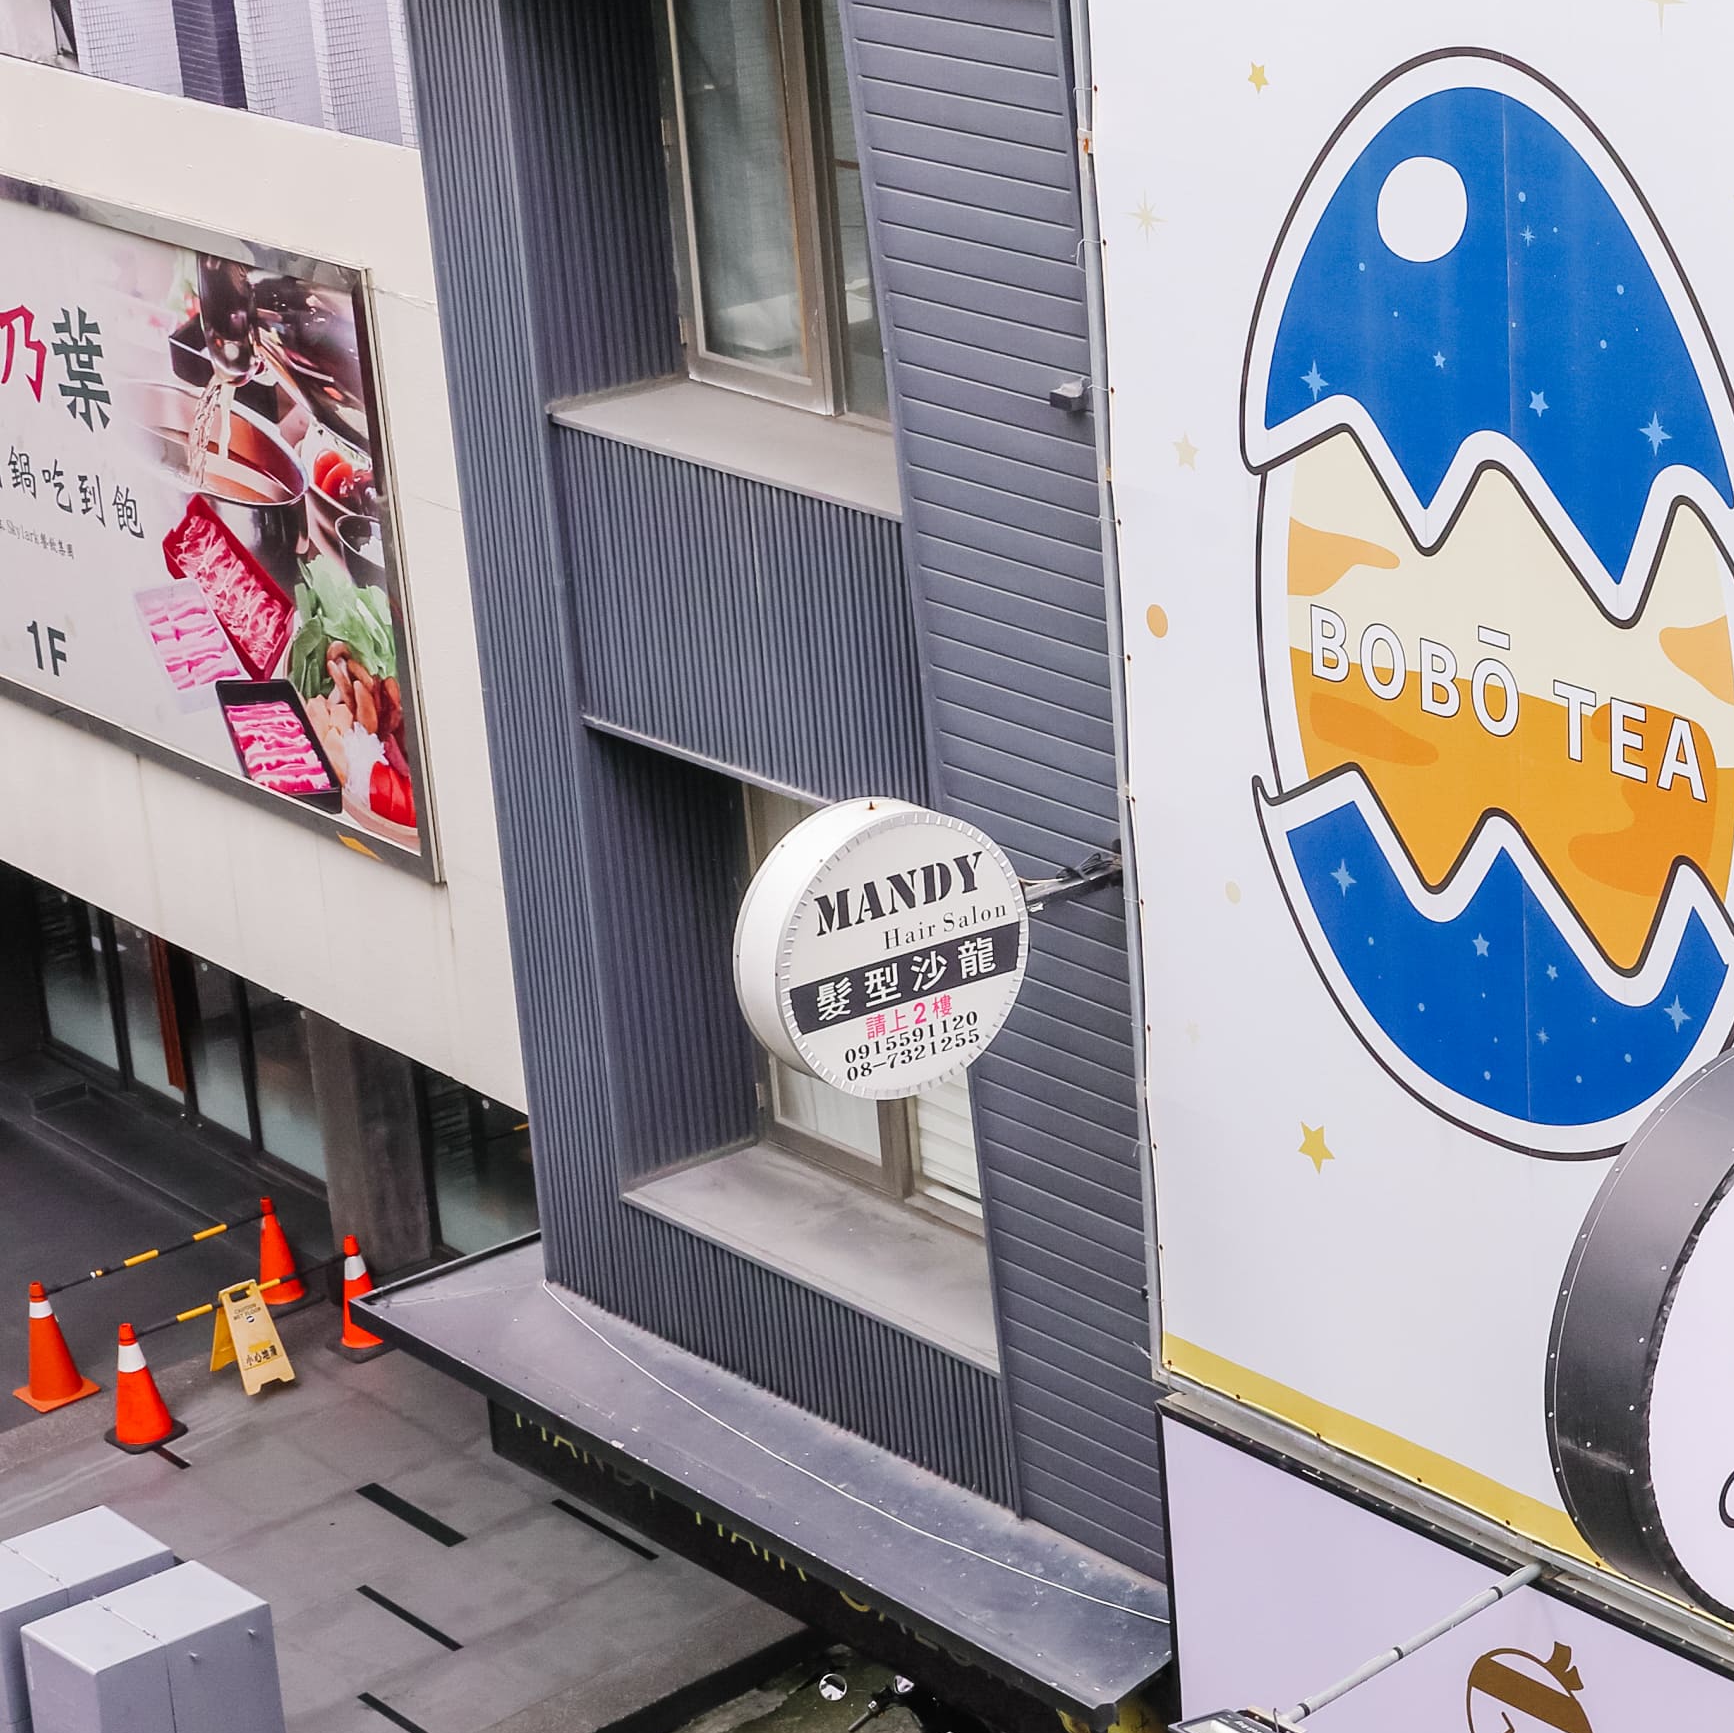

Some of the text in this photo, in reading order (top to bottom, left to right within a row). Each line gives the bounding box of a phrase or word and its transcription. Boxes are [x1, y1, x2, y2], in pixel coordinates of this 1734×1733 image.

[0, 444, 145, 540] 鍋吃到飽
[26, 619, 67, 678] 1F
[1552, 678, 1708, 803] TEA
[813, 850, 984, 938] MANDY
[883, 903, 1009, 951] Hair Salon
[815, 935, 997, 1023] 髮型沙龍
[844, 1010, 979, 1065] 0915591120
[865, 993, 954, 1041] 請上2樓
[846, 1027, 981, 1083] 08-7321255
